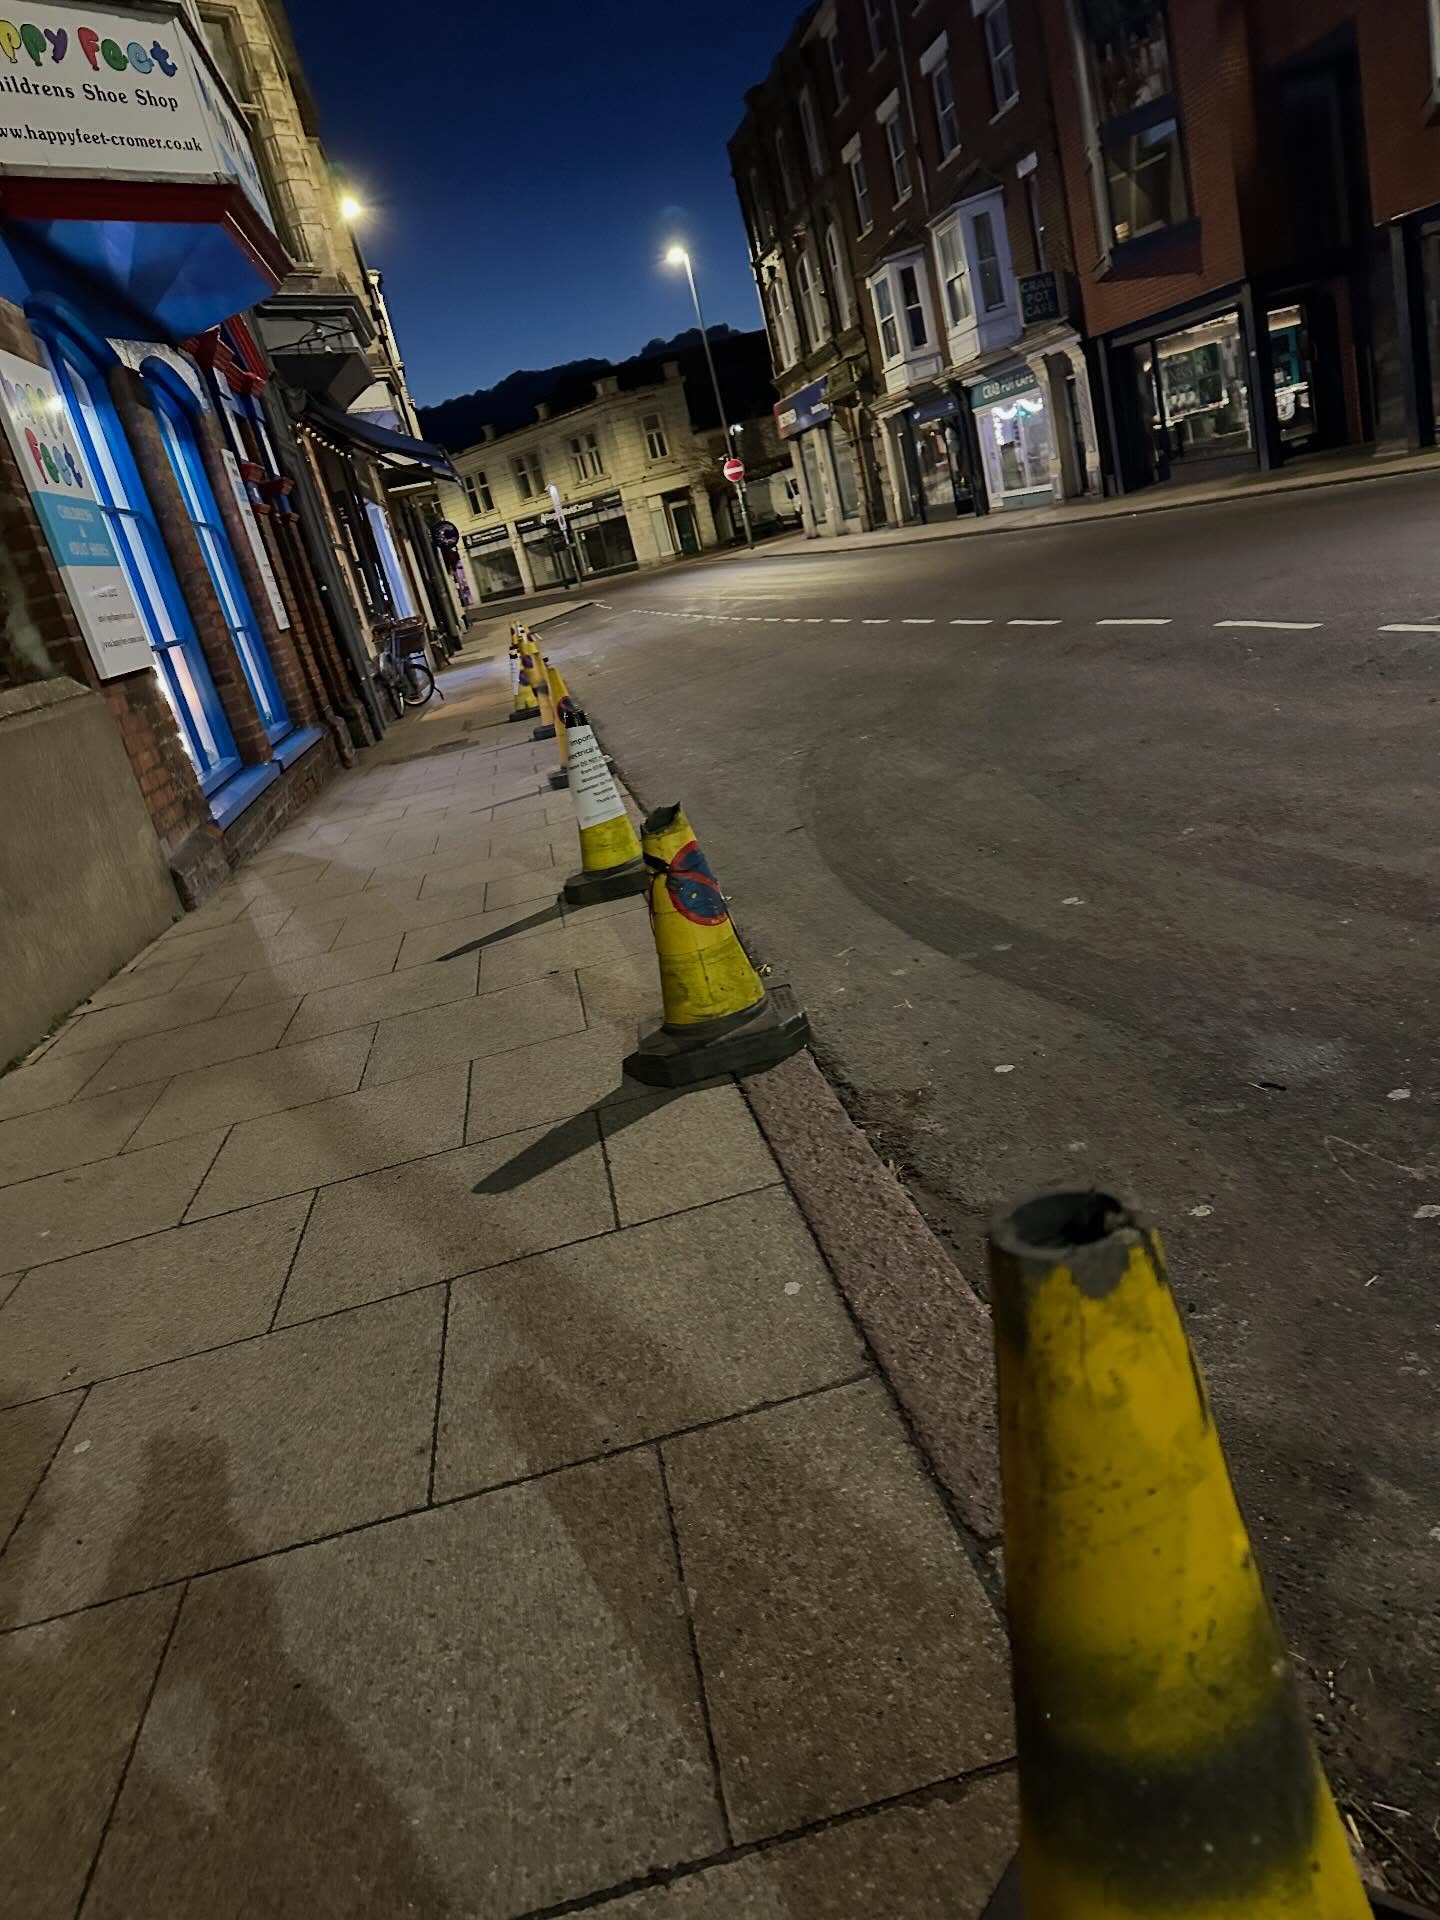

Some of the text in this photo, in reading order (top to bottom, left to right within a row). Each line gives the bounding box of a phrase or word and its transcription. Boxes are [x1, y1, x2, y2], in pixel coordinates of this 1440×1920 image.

[78, 26, 178, 77] Feet
[82, 83, 128, 104] Shoe
[134, 88, 179, 112] Shop
[1027, 291, 1049, 304] POT
